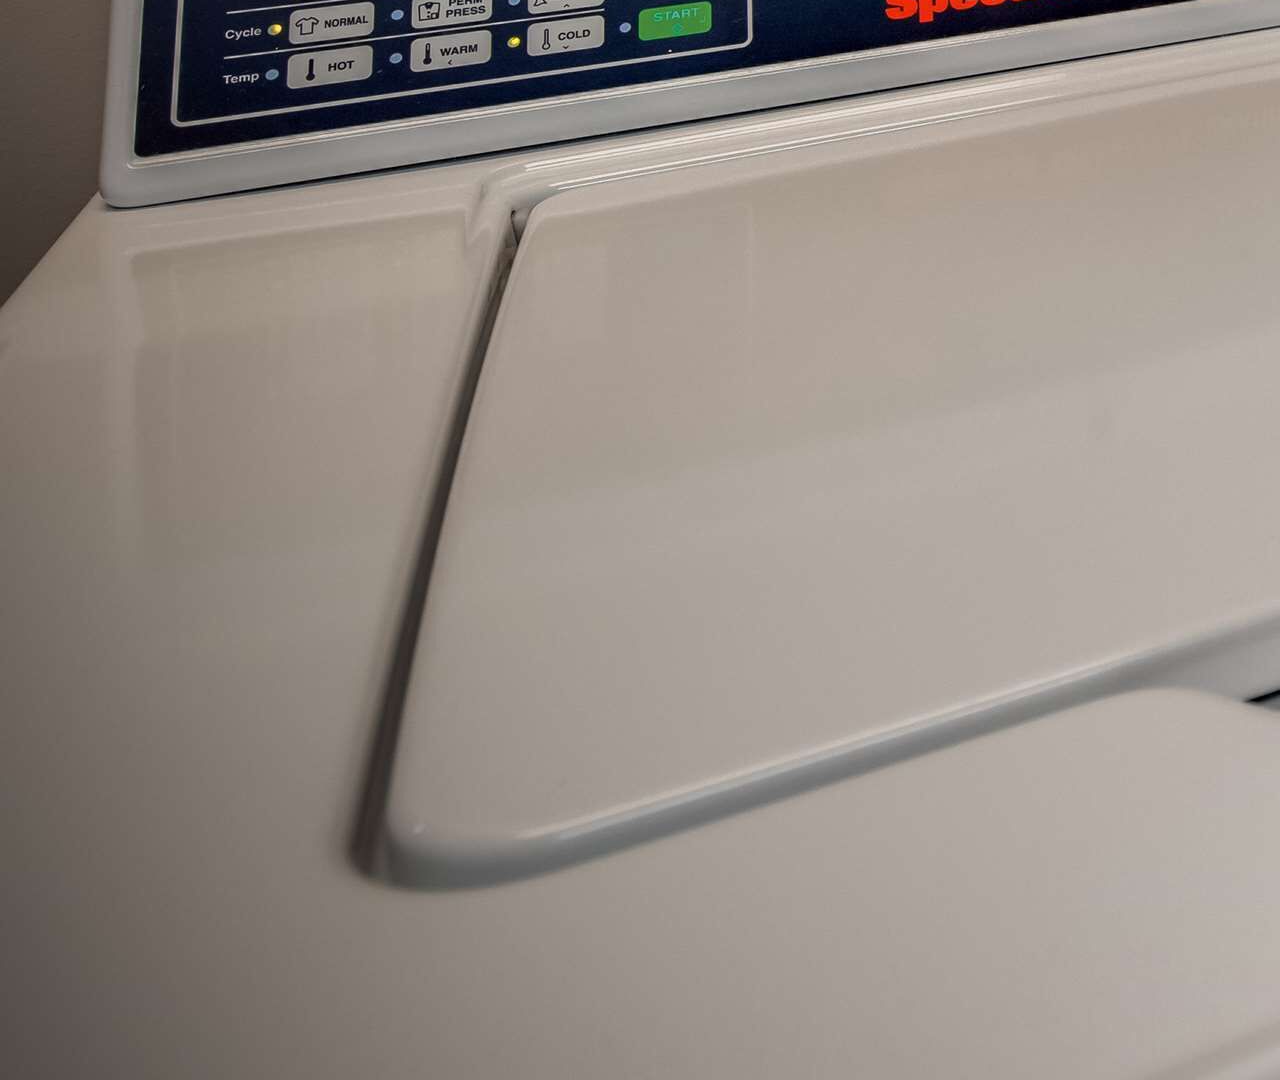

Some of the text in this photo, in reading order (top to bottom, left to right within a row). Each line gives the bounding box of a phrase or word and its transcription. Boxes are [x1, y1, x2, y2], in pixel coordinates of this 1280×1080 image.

[446, 5, 486, 18] PRESS
[653, 7, 699, 22] START
[324, 15, 369, 29] NORMAL
[225, 27, 262, 41] Cycle
[558, 28, 591, 42] COLD
[439, 43, 479, 57] WARM
[328, 60, 355, 72] HOT
[222, 72, 260, 85] Temp
